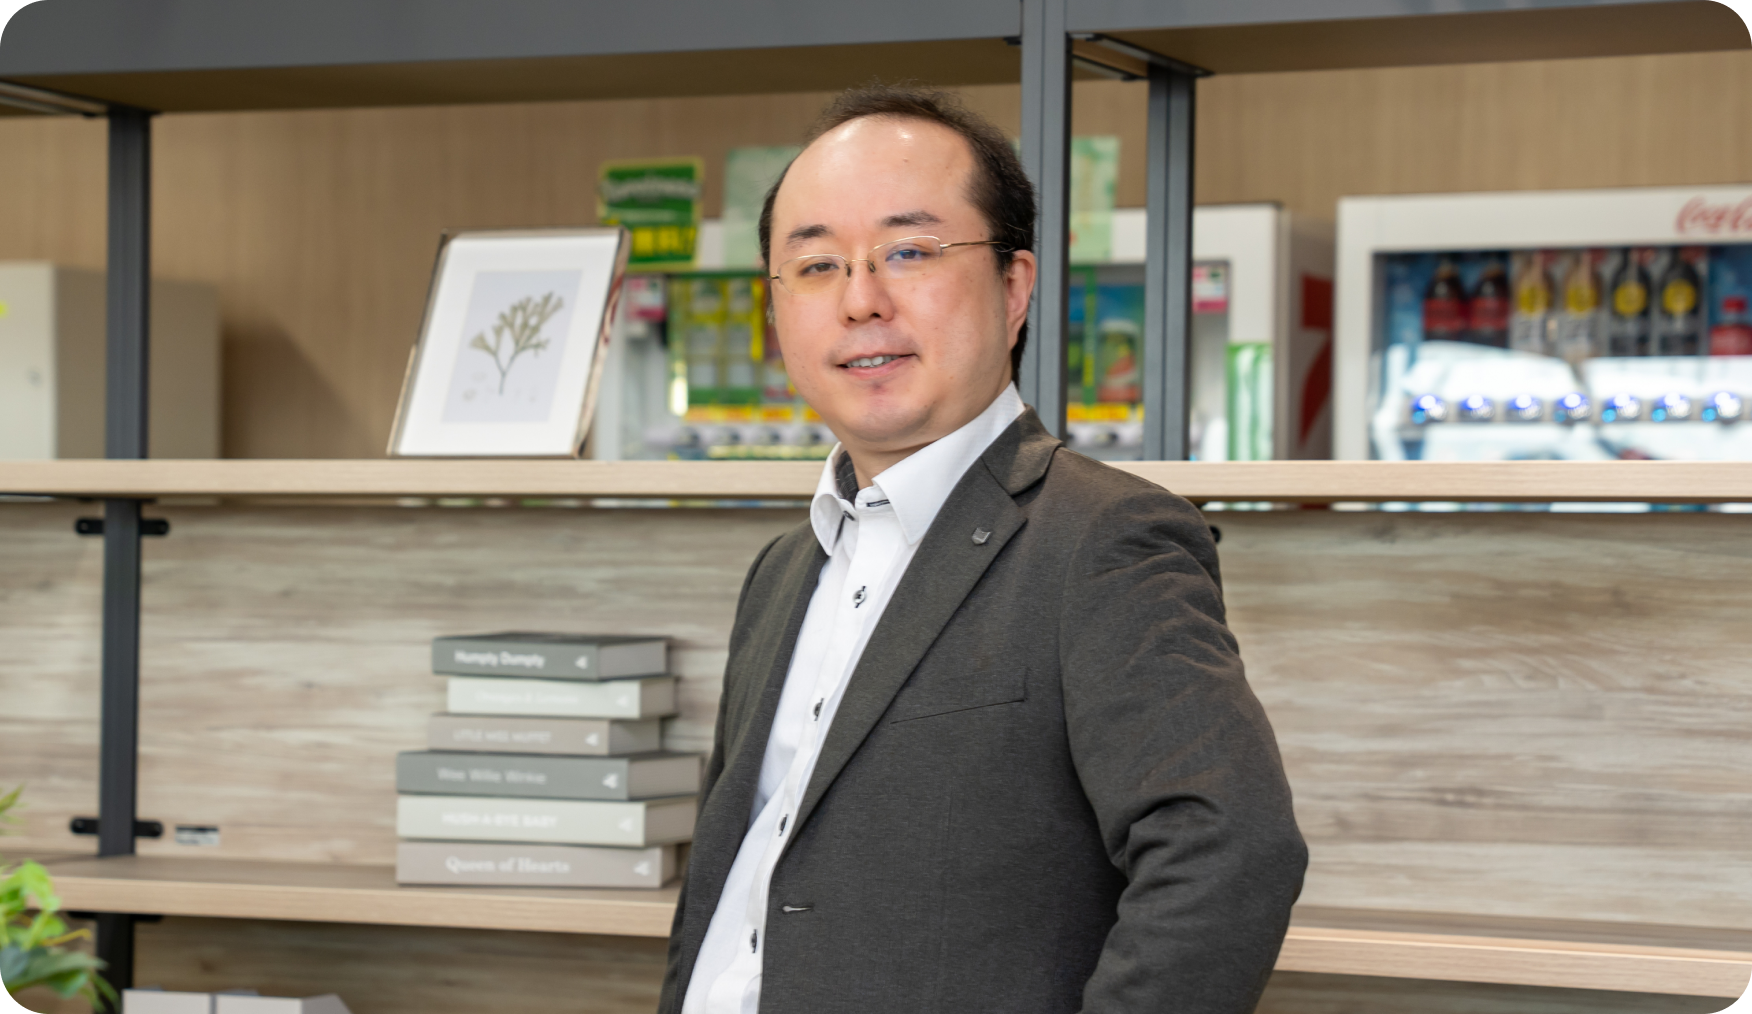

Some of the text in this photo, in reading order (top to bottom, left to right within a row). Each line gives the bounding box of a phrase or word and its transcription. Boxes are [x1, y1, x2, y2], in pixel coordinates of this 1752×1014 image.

[522, 814, 558, 828] BABY
[445, 855, 571, 874] Queen of Hearts
